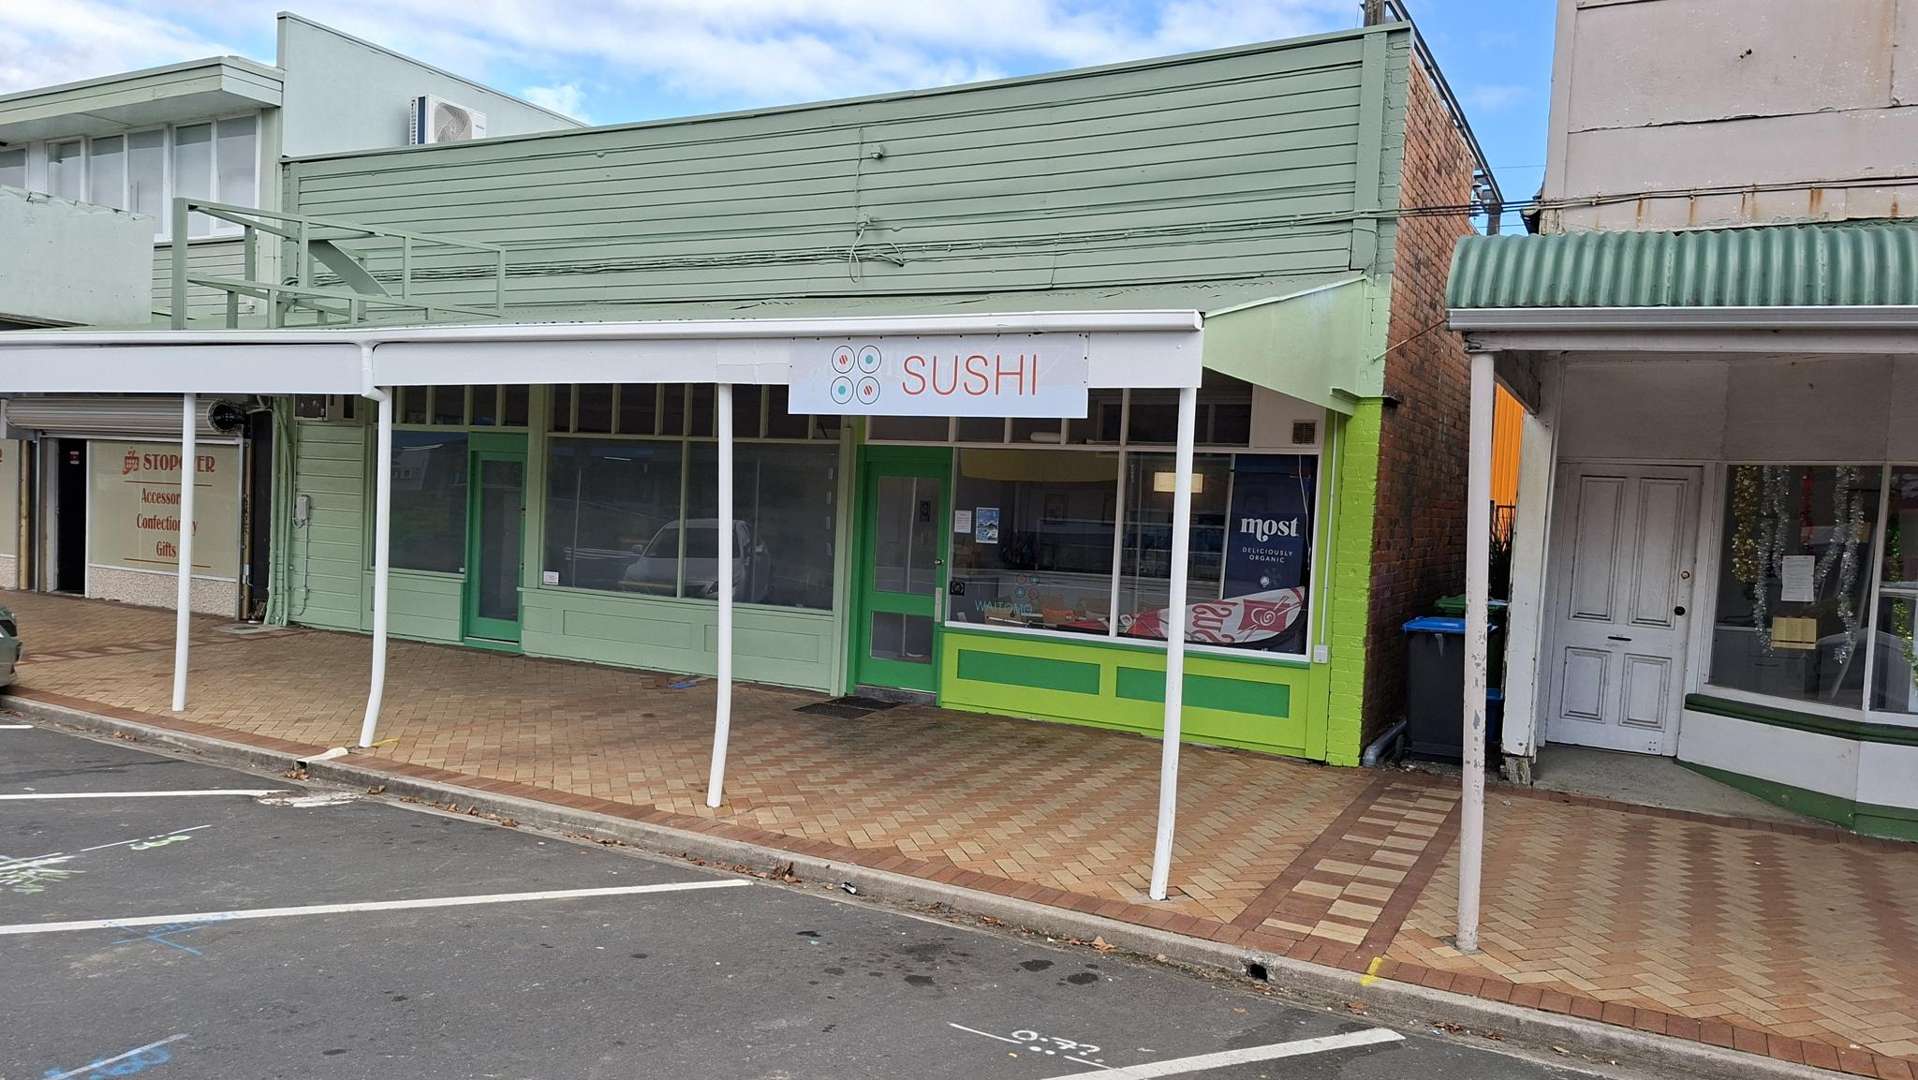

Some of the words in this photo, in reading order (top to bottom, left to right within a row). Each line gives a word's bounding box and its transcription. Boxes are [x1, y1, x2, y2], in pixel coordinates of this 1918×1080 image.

[902, 354, 1037, 396] SUSHI
[143, 453, 216, 473] STOPER
[1239, 517, 1299, 543] most
[155, 540, 177, 557] Gifts
[1242, 546, 1293, 557] DELICIOUSLY
[1248, 554, 1286, 564] ORGANIC
